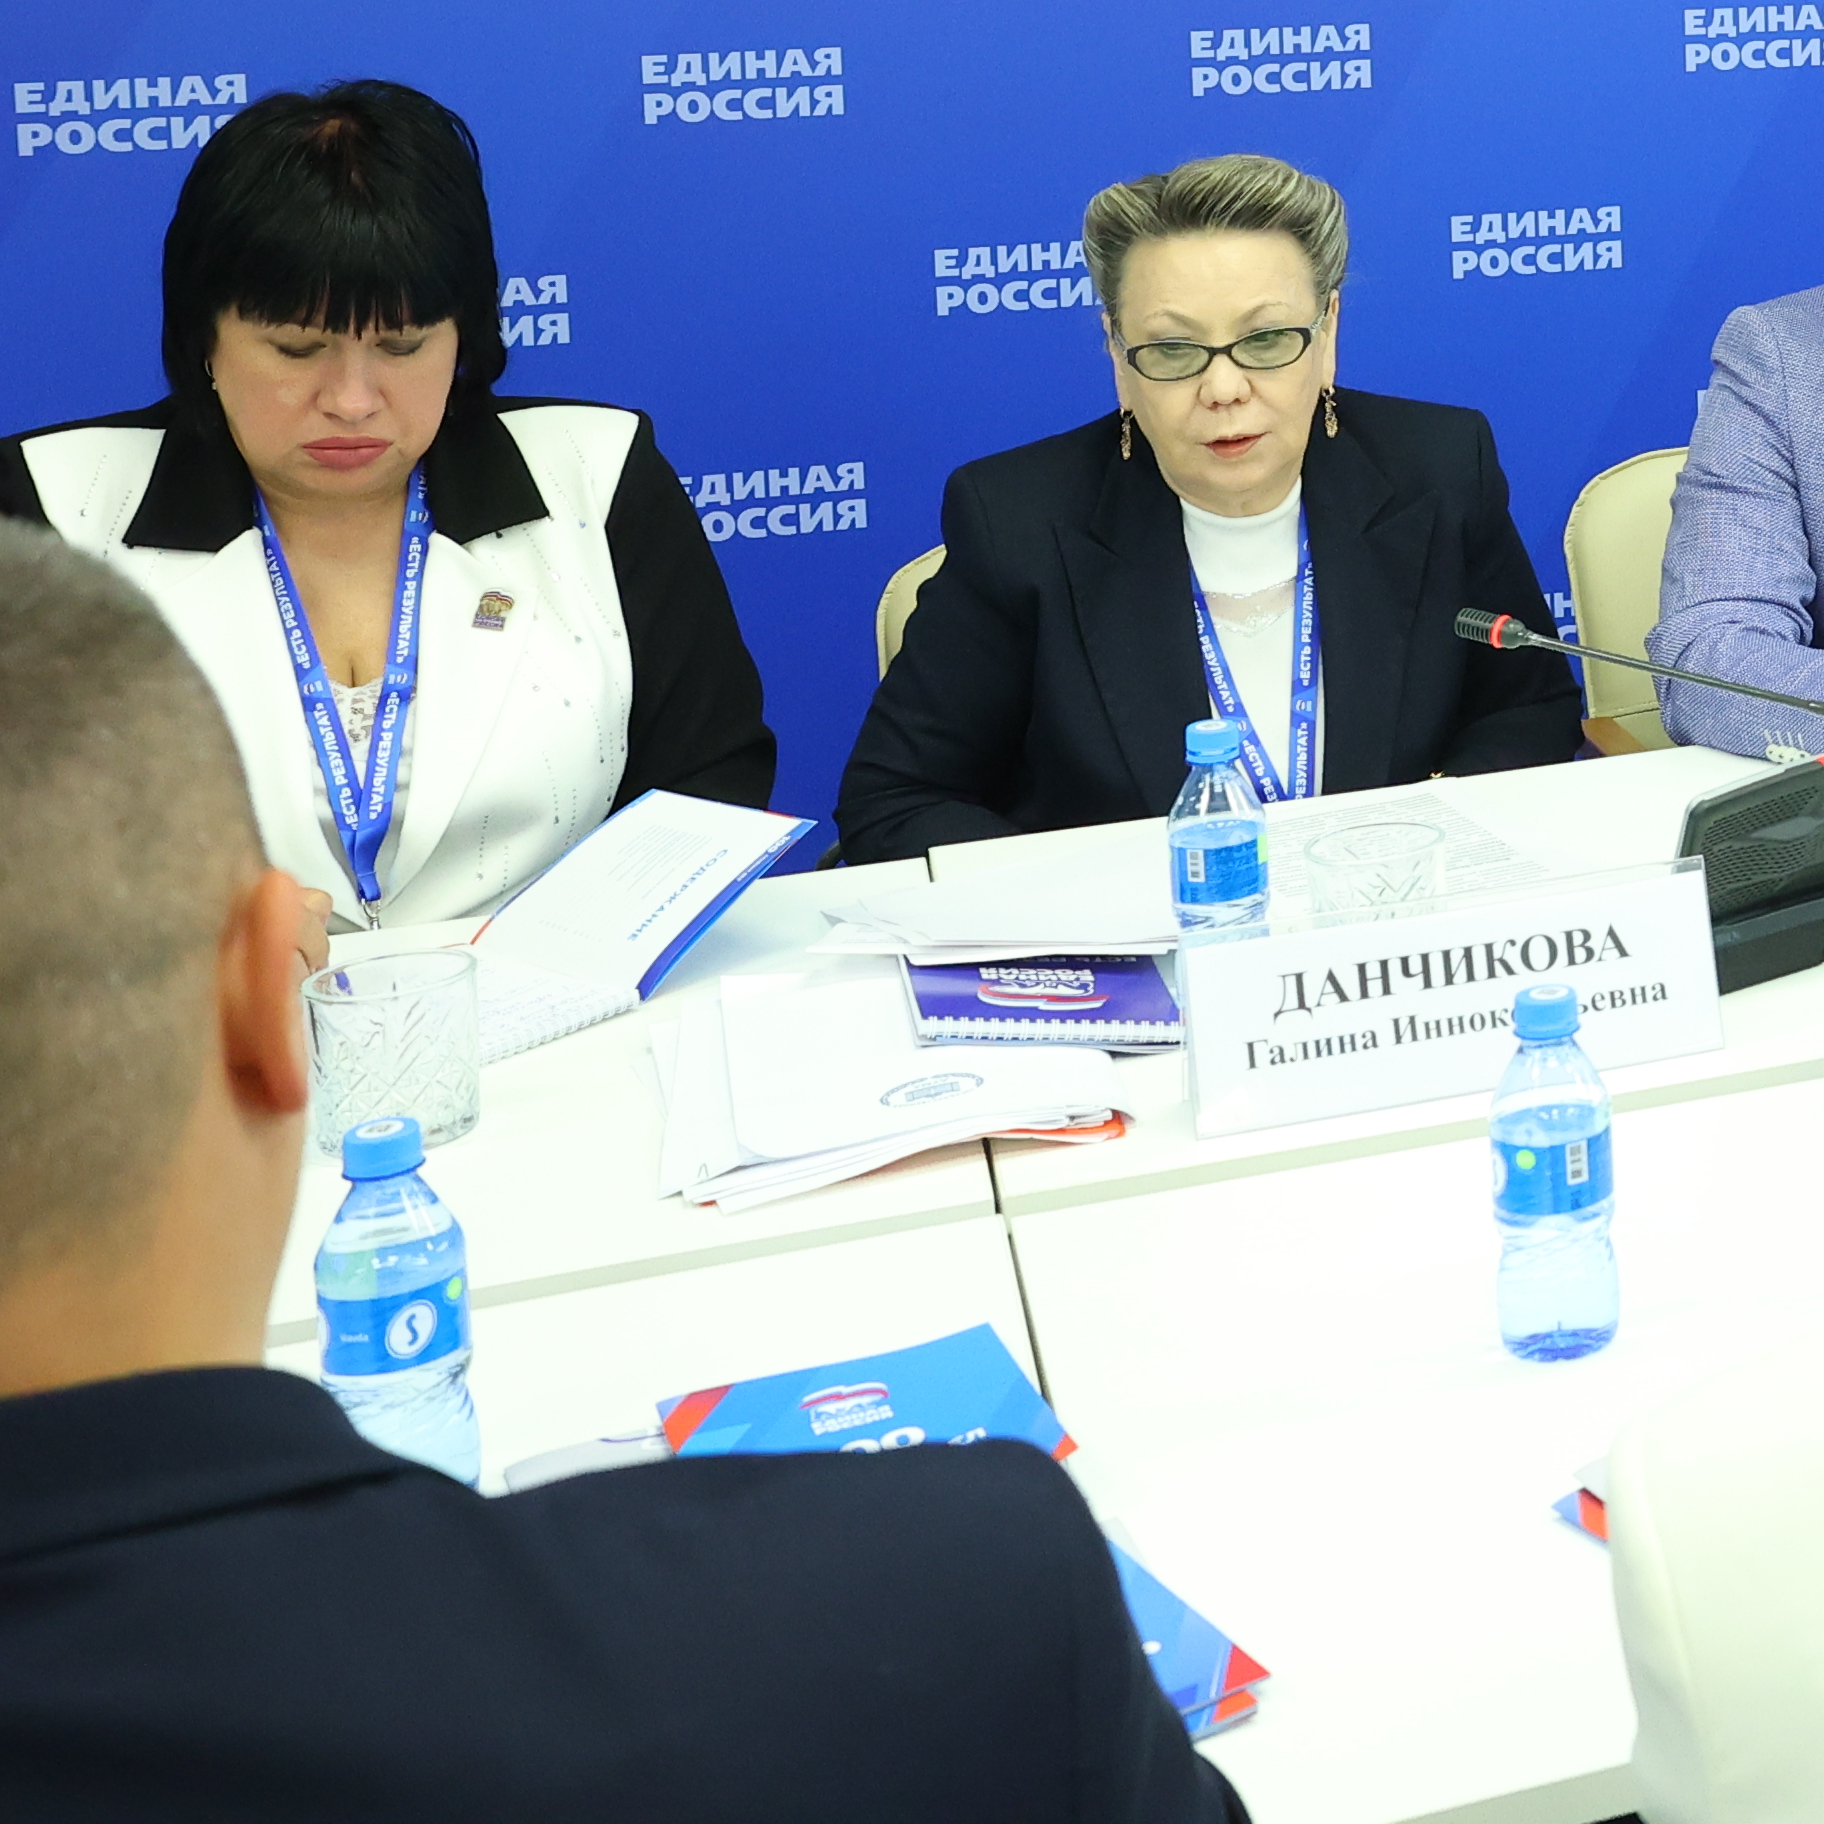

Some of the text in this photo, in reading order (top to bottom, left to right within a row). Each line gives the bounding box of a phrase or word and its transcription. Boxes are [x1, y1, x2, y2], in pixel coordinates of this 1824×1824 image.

[1190, 24, 1370, 61] ЕДИНАЯ
[641, 47, 842, 87] ЕДИНАЯ
[1192, 59, 1372, 96] РОССИЯ
[14, 74, 247, 116] ЕДИНАЯ
[643, 85, 844, 124] РОССИЯ
[16, 114, 235, 156] РОССИ
[1451, 206, 1621, 244] ЕДИНАЯ
[934, 240, 1088, 279] ЕДИНА
[1452, 240, 1622, 279] РОССИЯ
[936, 276, 1103, 316] РОССИ
[701, 498, 867, 542] ОССИЯ
[396, 536, 422, 664] «ЕСТЬ РЕЗУЛЬТАТ»
[1299, 562, 1314, 687] «ЕСТЬ РЕЗУЛЬТАТ»
[289, 628, 311, 669] «ЕСТЬ
[1200, 635, 1235, 713] РЕЗУЛЬТАТ»
[313, 702, 359, 830] «ЕСТЬ РЕЗУЛЬТАТ»
[369, 691, 400, 820] «ЕСТЬ РЕЗУЛЬТАТ»
[1241, 739, 1266, 777] «ЕСТЬ
[627, 849, 728, 942] СОДЕРЖАНИЕ
[1273, 923, 1632, 1024] ДАНЧИКОВА
[1244, 981, 1668, 1070] Галина Иннокьевна
